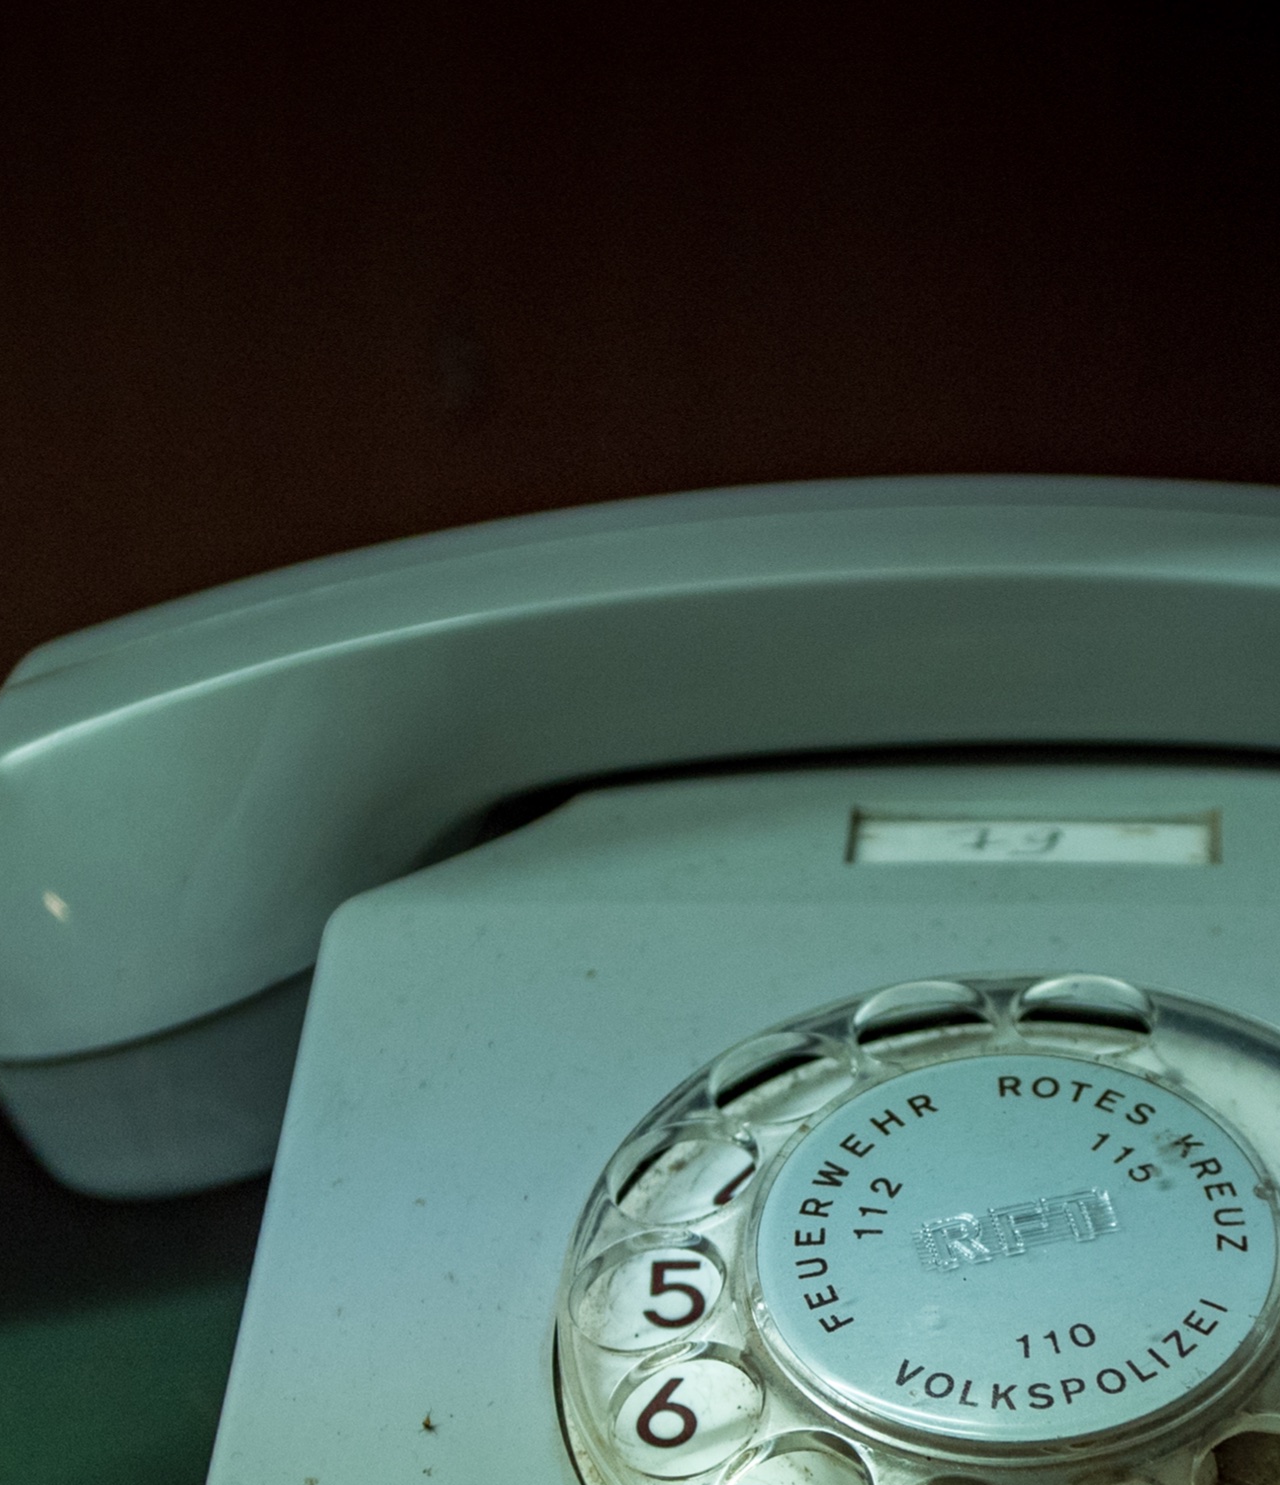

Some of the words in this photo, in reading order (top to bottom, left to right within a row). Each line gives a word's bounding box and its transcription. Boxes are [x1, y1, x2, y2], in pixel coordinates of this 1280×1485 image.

[998, 1076, 1157, 1125] ROTES
[1174, 1133, 1248, 1252] KREUZ
[1091, 1132, 1153, 1182] 115
[795, 1094, 938, 1333] FEUERWEHR
[853, 1177, 903, 1239] 112
[643, 1260, 705, 1328] 5
[895, 1299, 1228, 1411] VOLKSPOLIZEI
[1016, 1323, 1096, 1359] 110
[636, 1377, 697, 1448] 6
